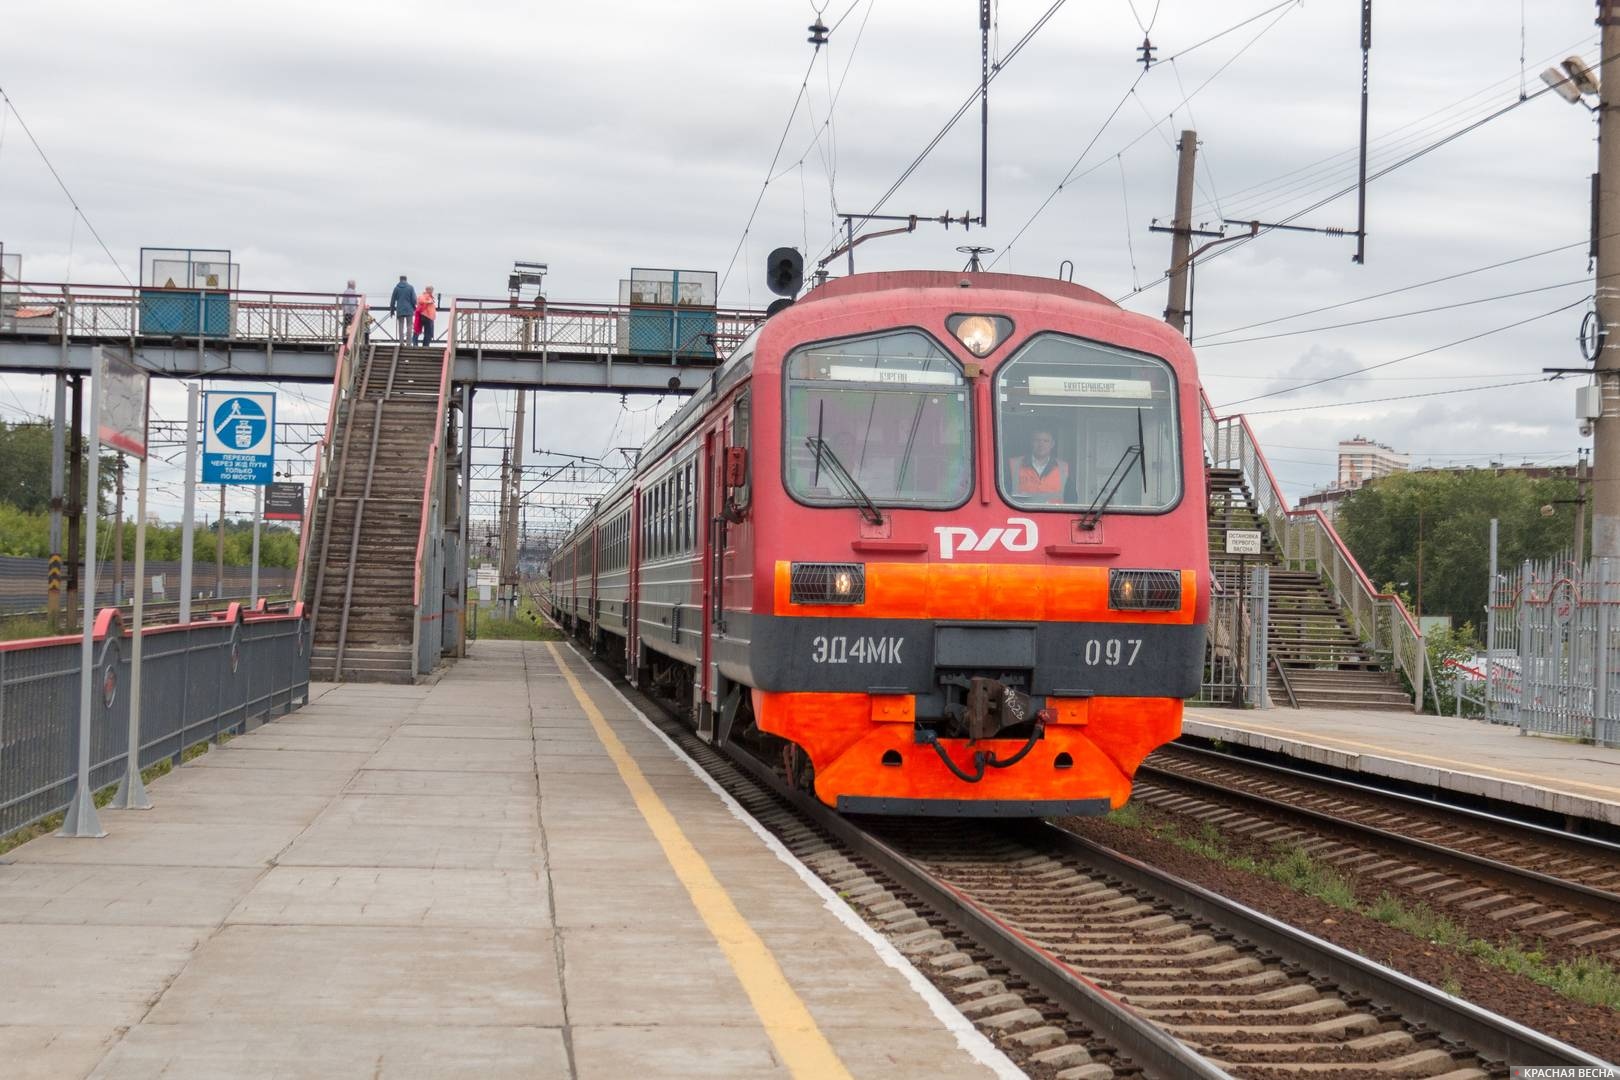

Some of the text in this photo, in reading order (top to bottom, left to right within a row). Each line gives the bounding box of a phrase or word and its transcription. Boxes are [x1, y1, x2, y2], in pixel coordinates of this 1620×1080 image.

[222, 454, 256, 462] ПЕРЕХОД
[248, 461, 267, 469] ПУТИ
[812, 636, 904, 664] ЭД4МК
[1085, 639, 1142, 666] 097
